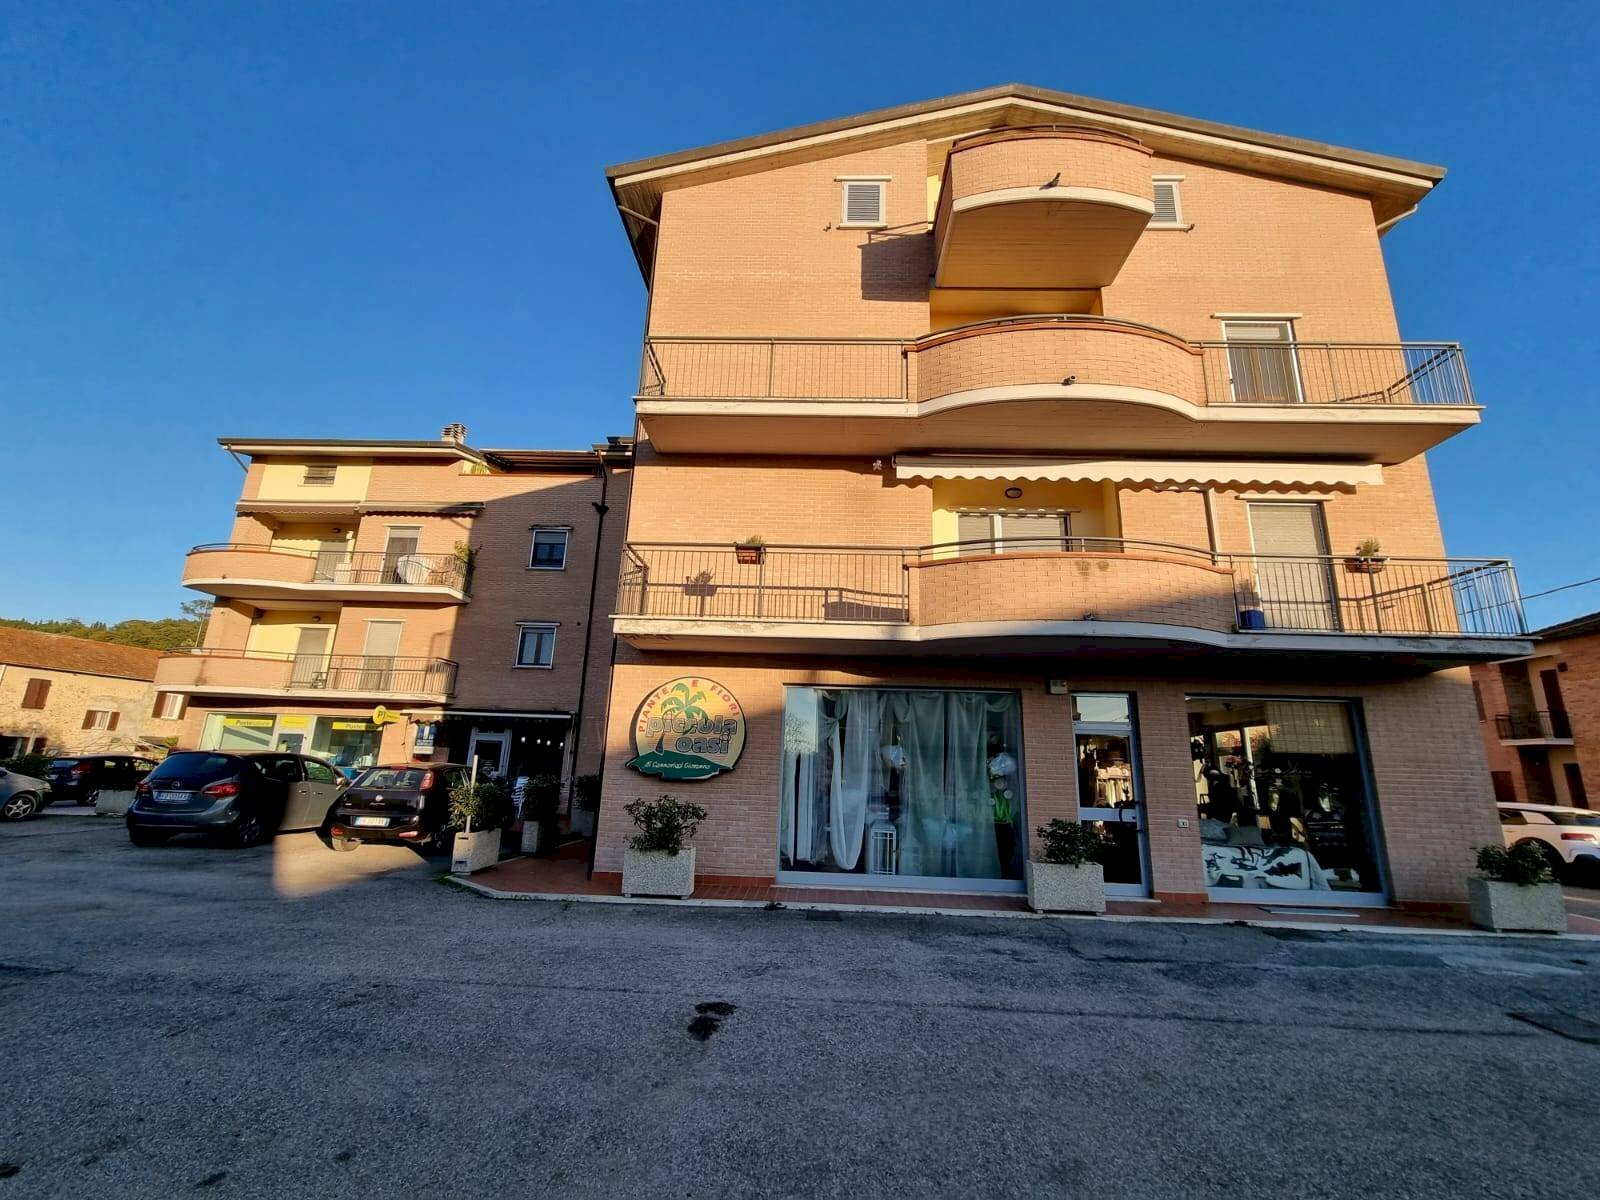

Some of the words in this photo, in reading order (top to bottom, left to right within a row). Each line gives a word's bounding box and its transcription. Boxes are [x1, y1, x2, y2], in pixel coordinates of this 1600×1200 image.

[639, 687, 670, 733] PIANTE
[710, 684, 740, 717] FIORI
[646, 715, 738, 737] piccola
[675, 731, 732, 754] oasi
